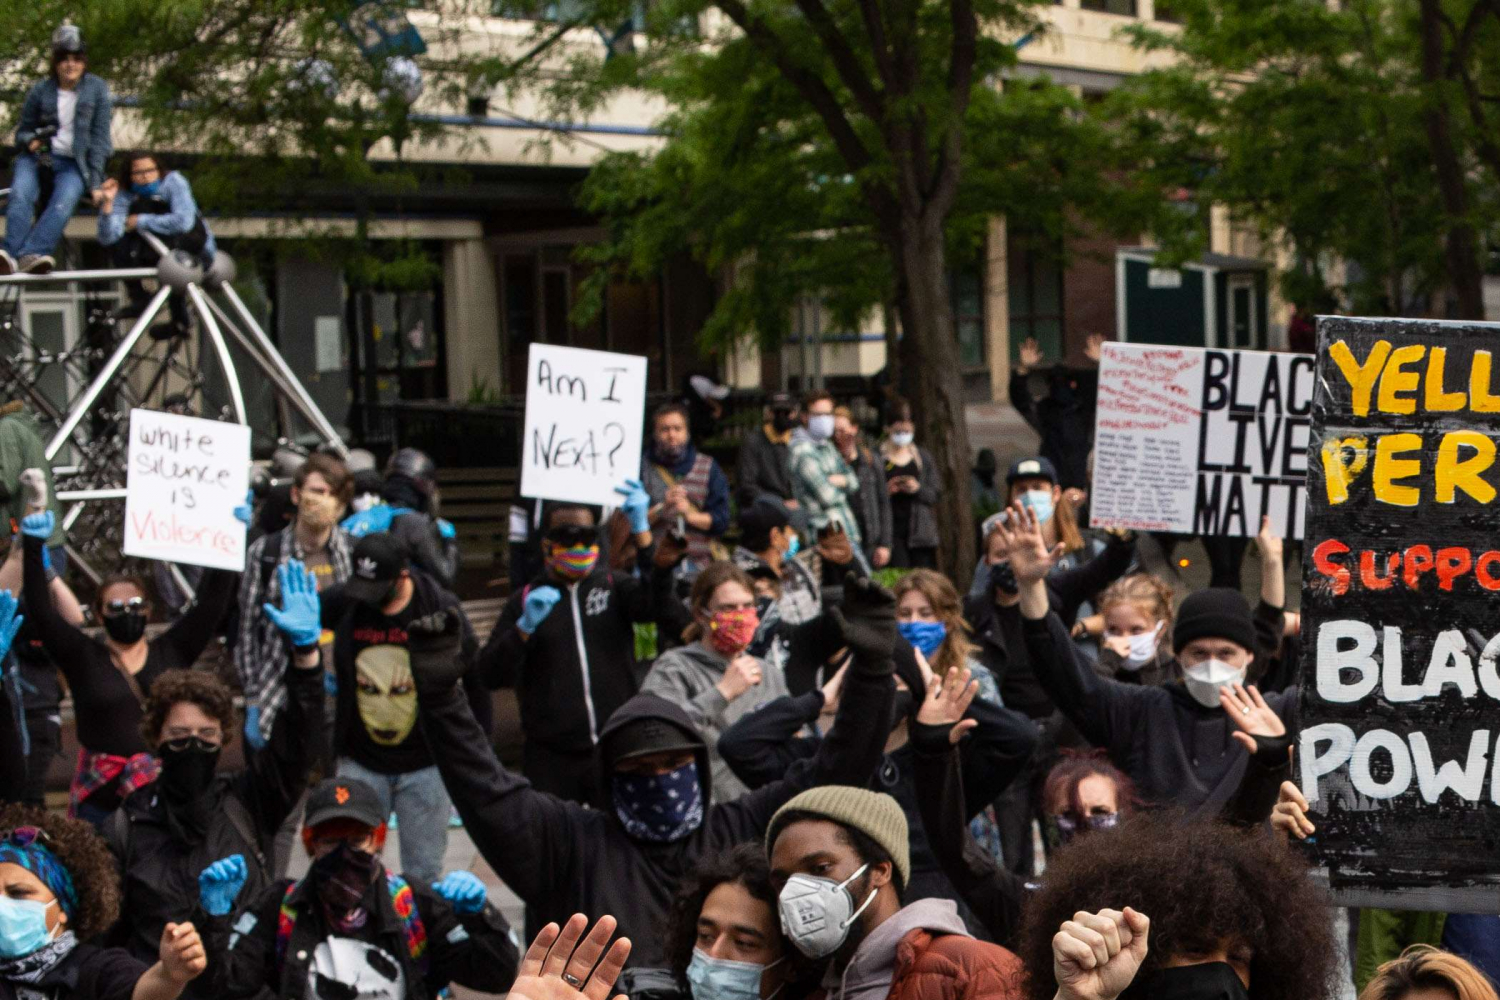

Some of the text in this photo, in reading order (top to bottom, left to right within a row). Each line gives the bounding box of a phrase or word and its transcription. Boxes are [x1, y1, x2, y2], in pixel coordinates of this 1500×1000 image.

[538, 359, 628, 404] Am I
[1203, 351, 1314, 415] BLAC
[1198, 412, 1311, 477] LIVE
[1193, 474, 1307, 538] MATT
